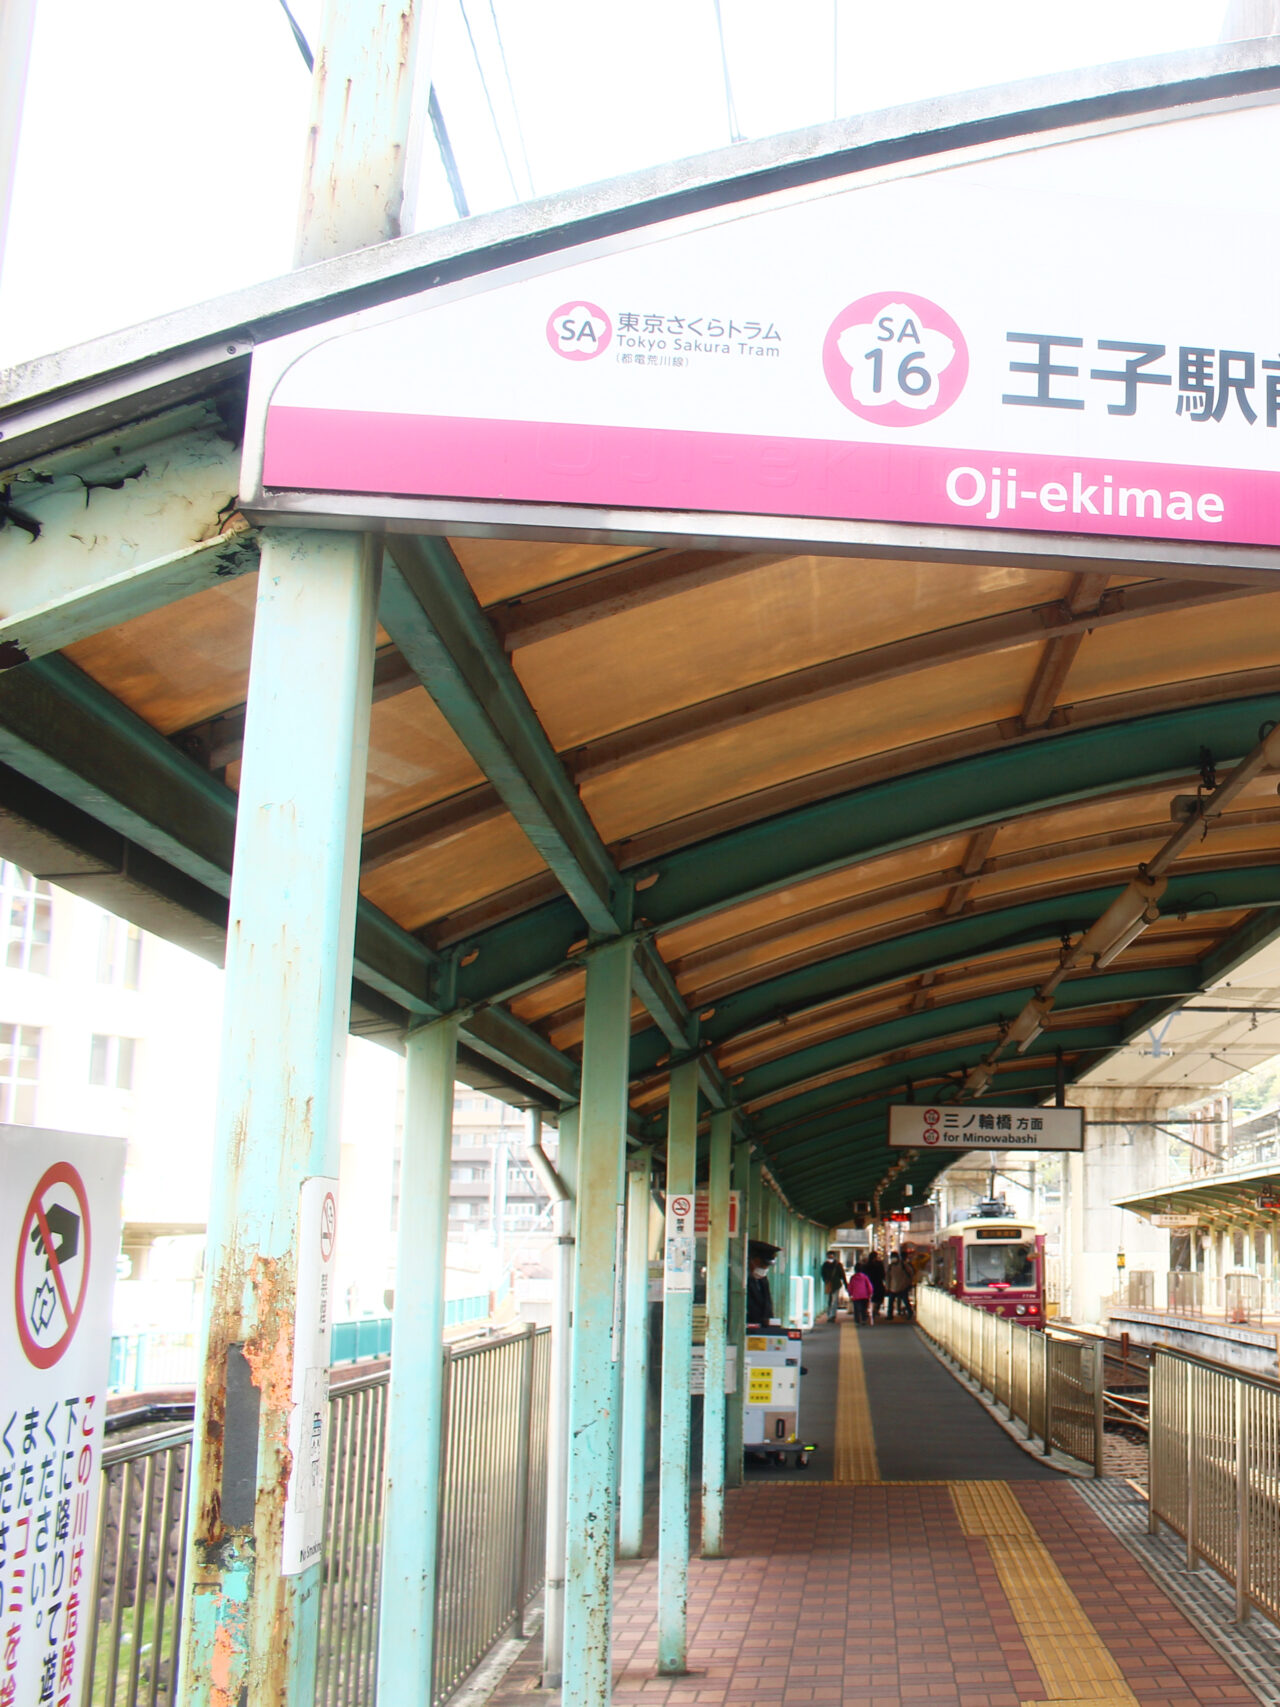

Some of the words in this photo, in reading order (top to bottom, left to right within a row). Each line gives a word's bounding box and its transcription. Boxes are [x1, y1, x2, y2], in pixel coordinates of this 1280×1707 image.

[560, 319, 598, 343] SA
[617, 312, 782, 342] 東京さくらトラム
[876, 316, 921, 345] SA
[616, 334, 668, 352] Tokyo
[673, 337, 731, 354] Sakura
[737, 341, 781, 358] Tram
[863, 347, 933, 397] 16
[945, 466, 1225, 524] Oji-ekimae
[944, 1114, 1012, 1130] 三ノ輪橋
[1017, 1117, 1044, 1131] 方面
[943, 1132, 960, 1142] for
[963, 1133, 1037, 1144] Minowabashi
[39, 1397, 80, 1707] 下に降りて遊
